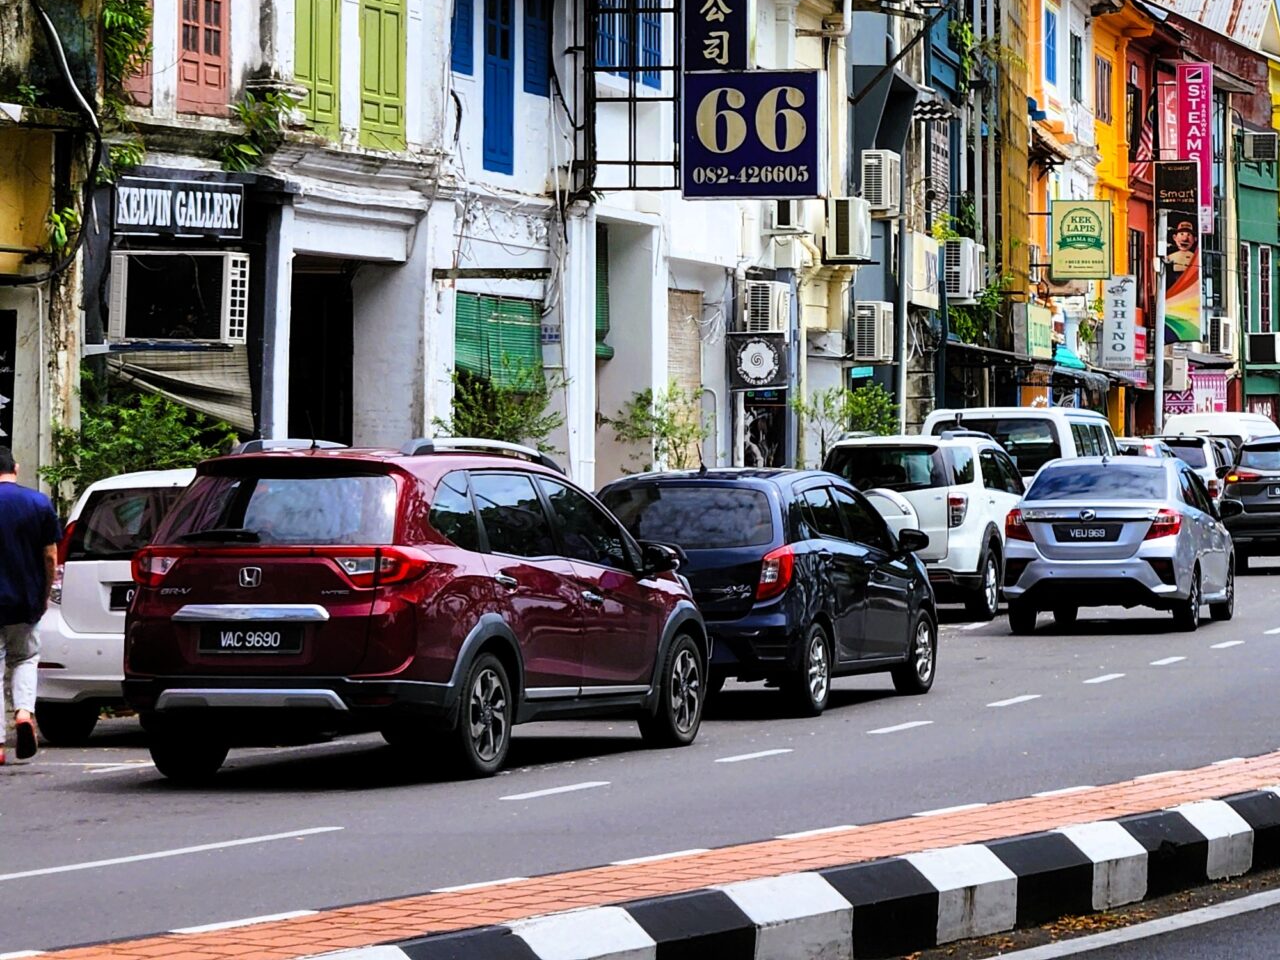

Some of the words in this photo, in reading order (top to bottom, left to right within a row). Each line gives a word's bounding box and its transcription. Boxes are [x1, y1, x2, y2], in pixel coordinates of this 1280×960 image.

[695, 86, 807, 155] 66
[693, 164, 810, 186] 082-426605
[117, 188, 173, 228] KELVIN
[175, 190, 241, 230] GALLERY
[1066, 224, 1096, 233] LAPIS
[1071, 216, 1092, 224] KEK
[1111, 299, 1127, 352] RHINO
[1070, 529, 1087, 538] VEU
[1088, 529, 1105, 537] 969
[220, 631, 243, 647] VAC
[245, 631, 281, 647] 9690
